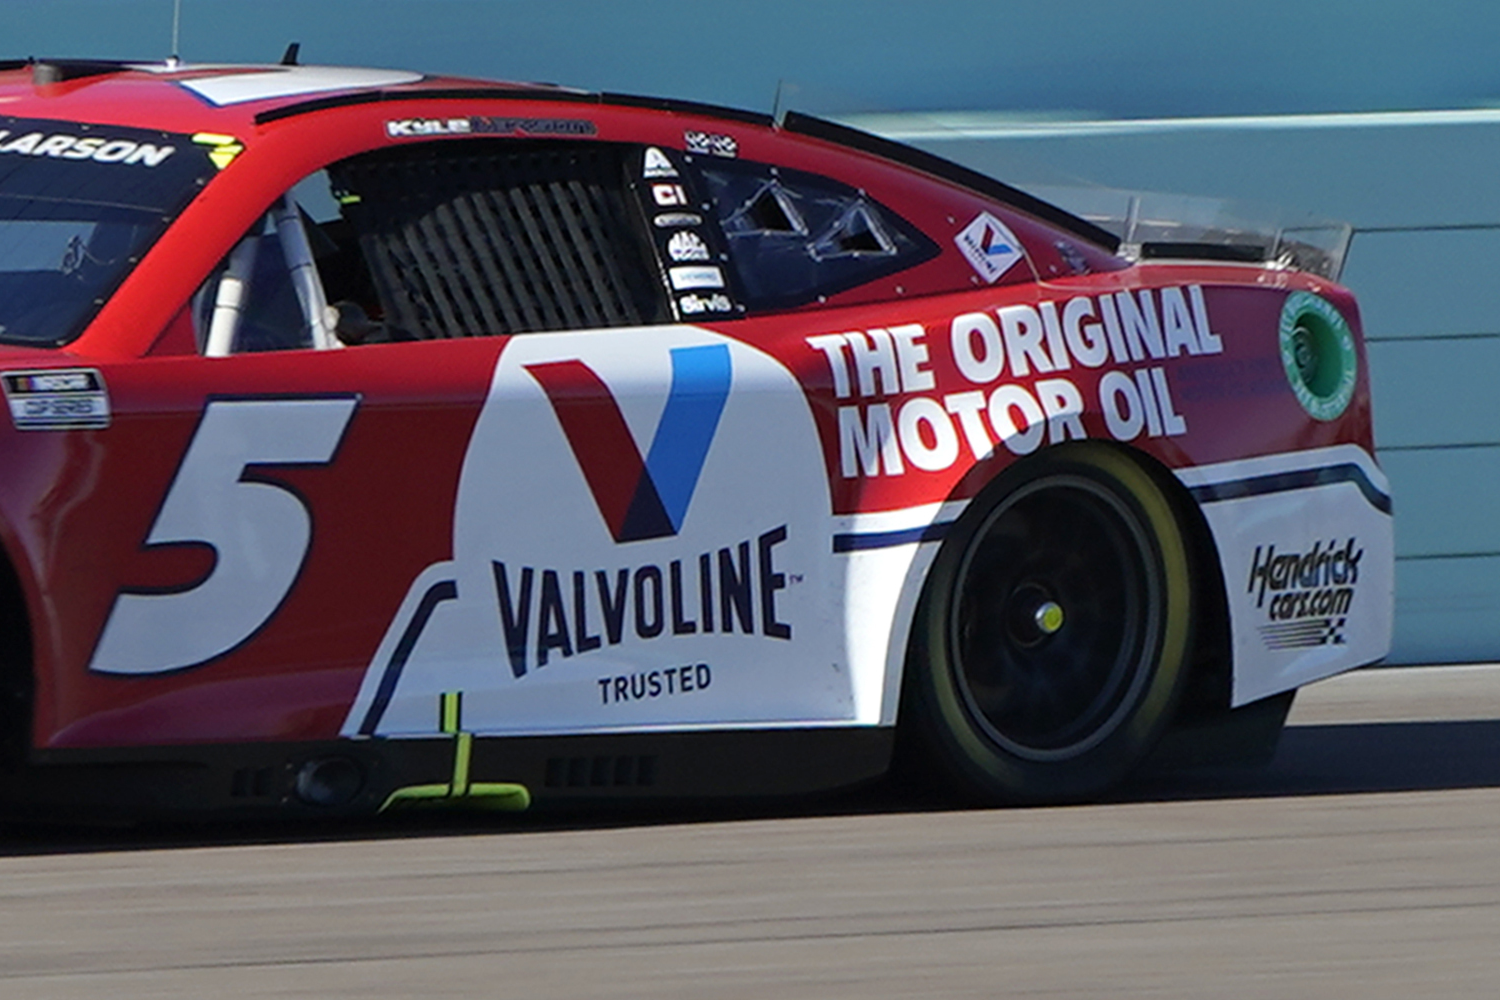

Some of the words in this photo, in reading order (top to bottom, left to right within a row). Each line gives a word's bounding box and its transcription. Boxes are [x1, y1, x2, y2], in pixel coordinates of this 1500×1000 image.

[805, 323, 936, 399] THE
[950, 284, 1224, 384] ORIGINAL
[837, 377, 1088, 479] MOTOR
[1099, 366, 1188, 443] OIL
[88, 392, 363, 679] 5
[1247, 536, 1365, 609] Hendrick
[490, 523, 793, 680] VALVOLINE
[597, 663, 713, 705] TRUSTED
